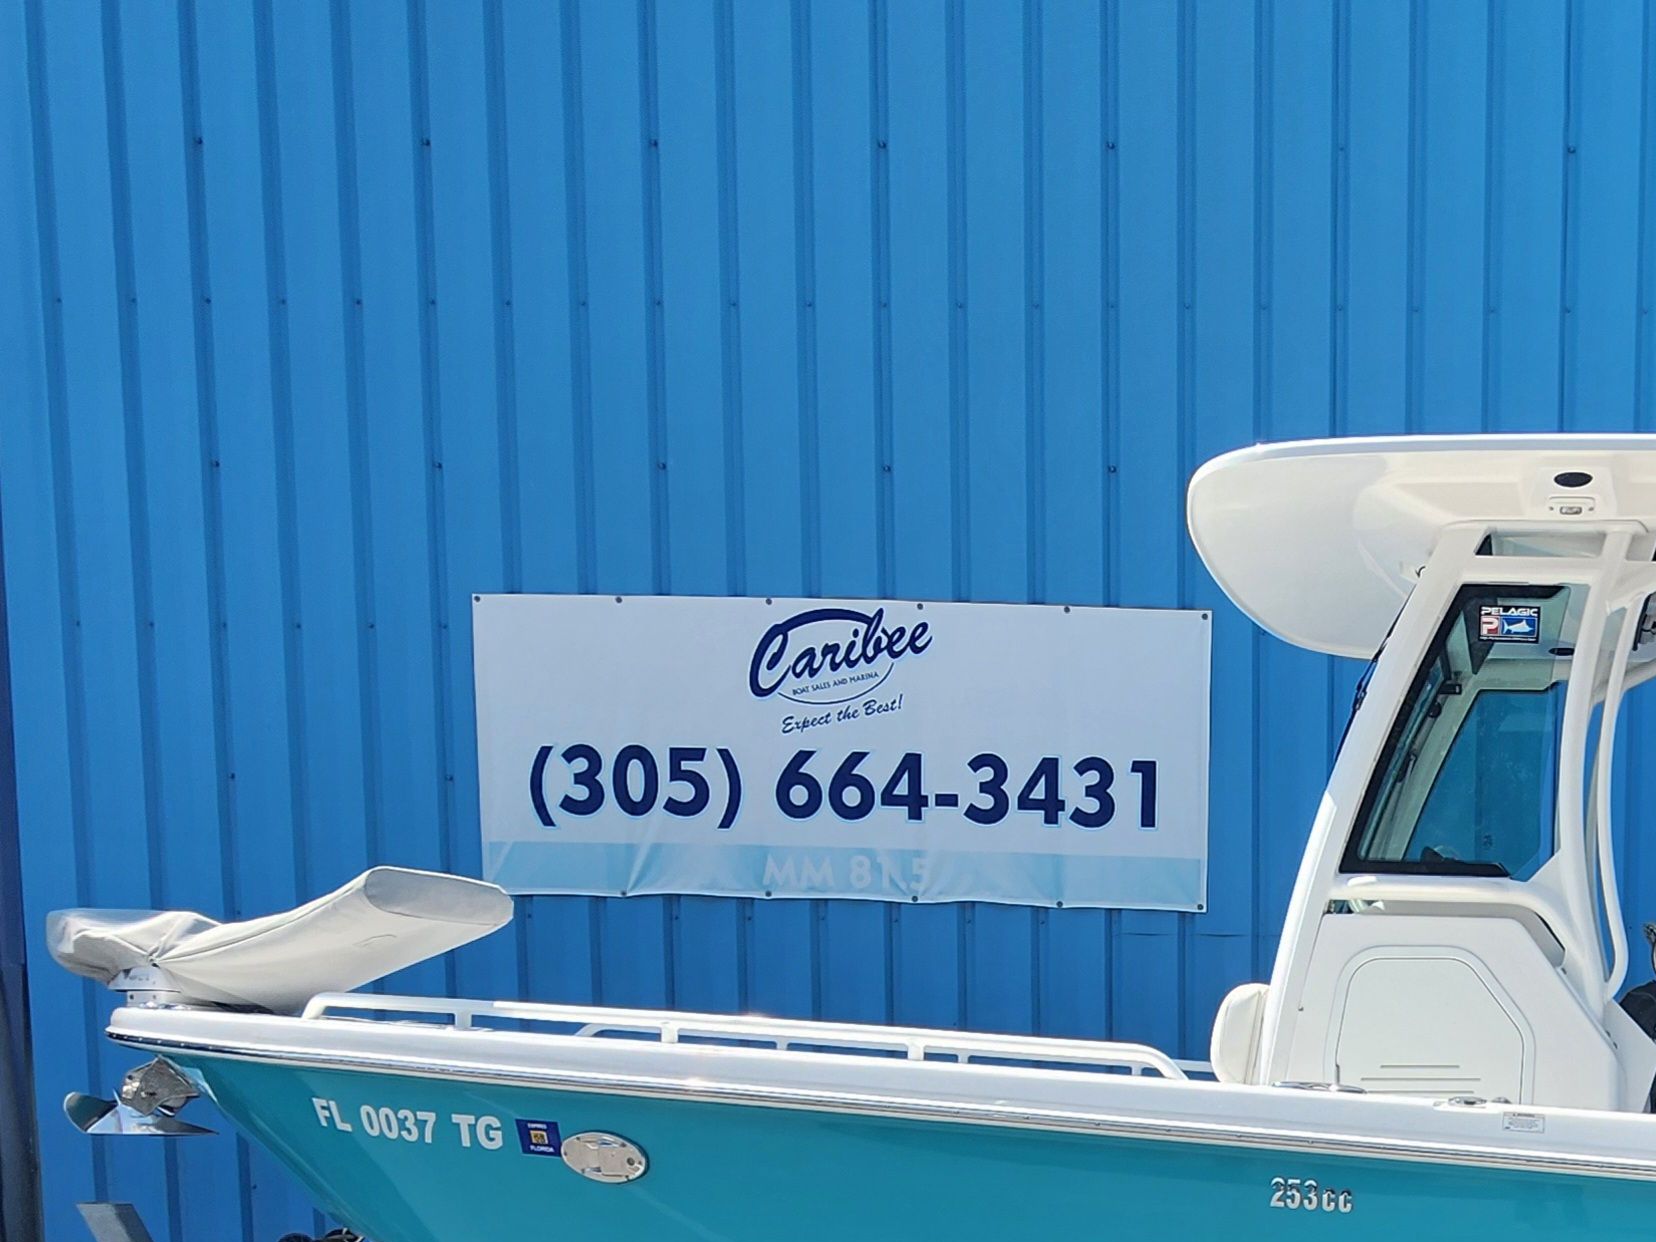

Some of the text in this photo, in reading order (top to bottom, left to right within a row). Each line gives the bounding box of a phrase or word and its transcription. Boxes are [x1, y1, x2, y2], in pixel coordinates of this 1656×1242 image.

[1481, 606, 1538, 617] PELAGIC
[749, 607, 933, 698] Caribee
[792, 671, 879, 696] BOAT SALES AND MARINA
[782, 693, 904, 734] Expect the Best!
[529, 744, 1158, 829] (305) 664-3431
[762, 853, 835, 887] MM
[312, 1097, 503, 1150] FL 0037 TG
[1269, 1177, 1353, 1214] 253cc
